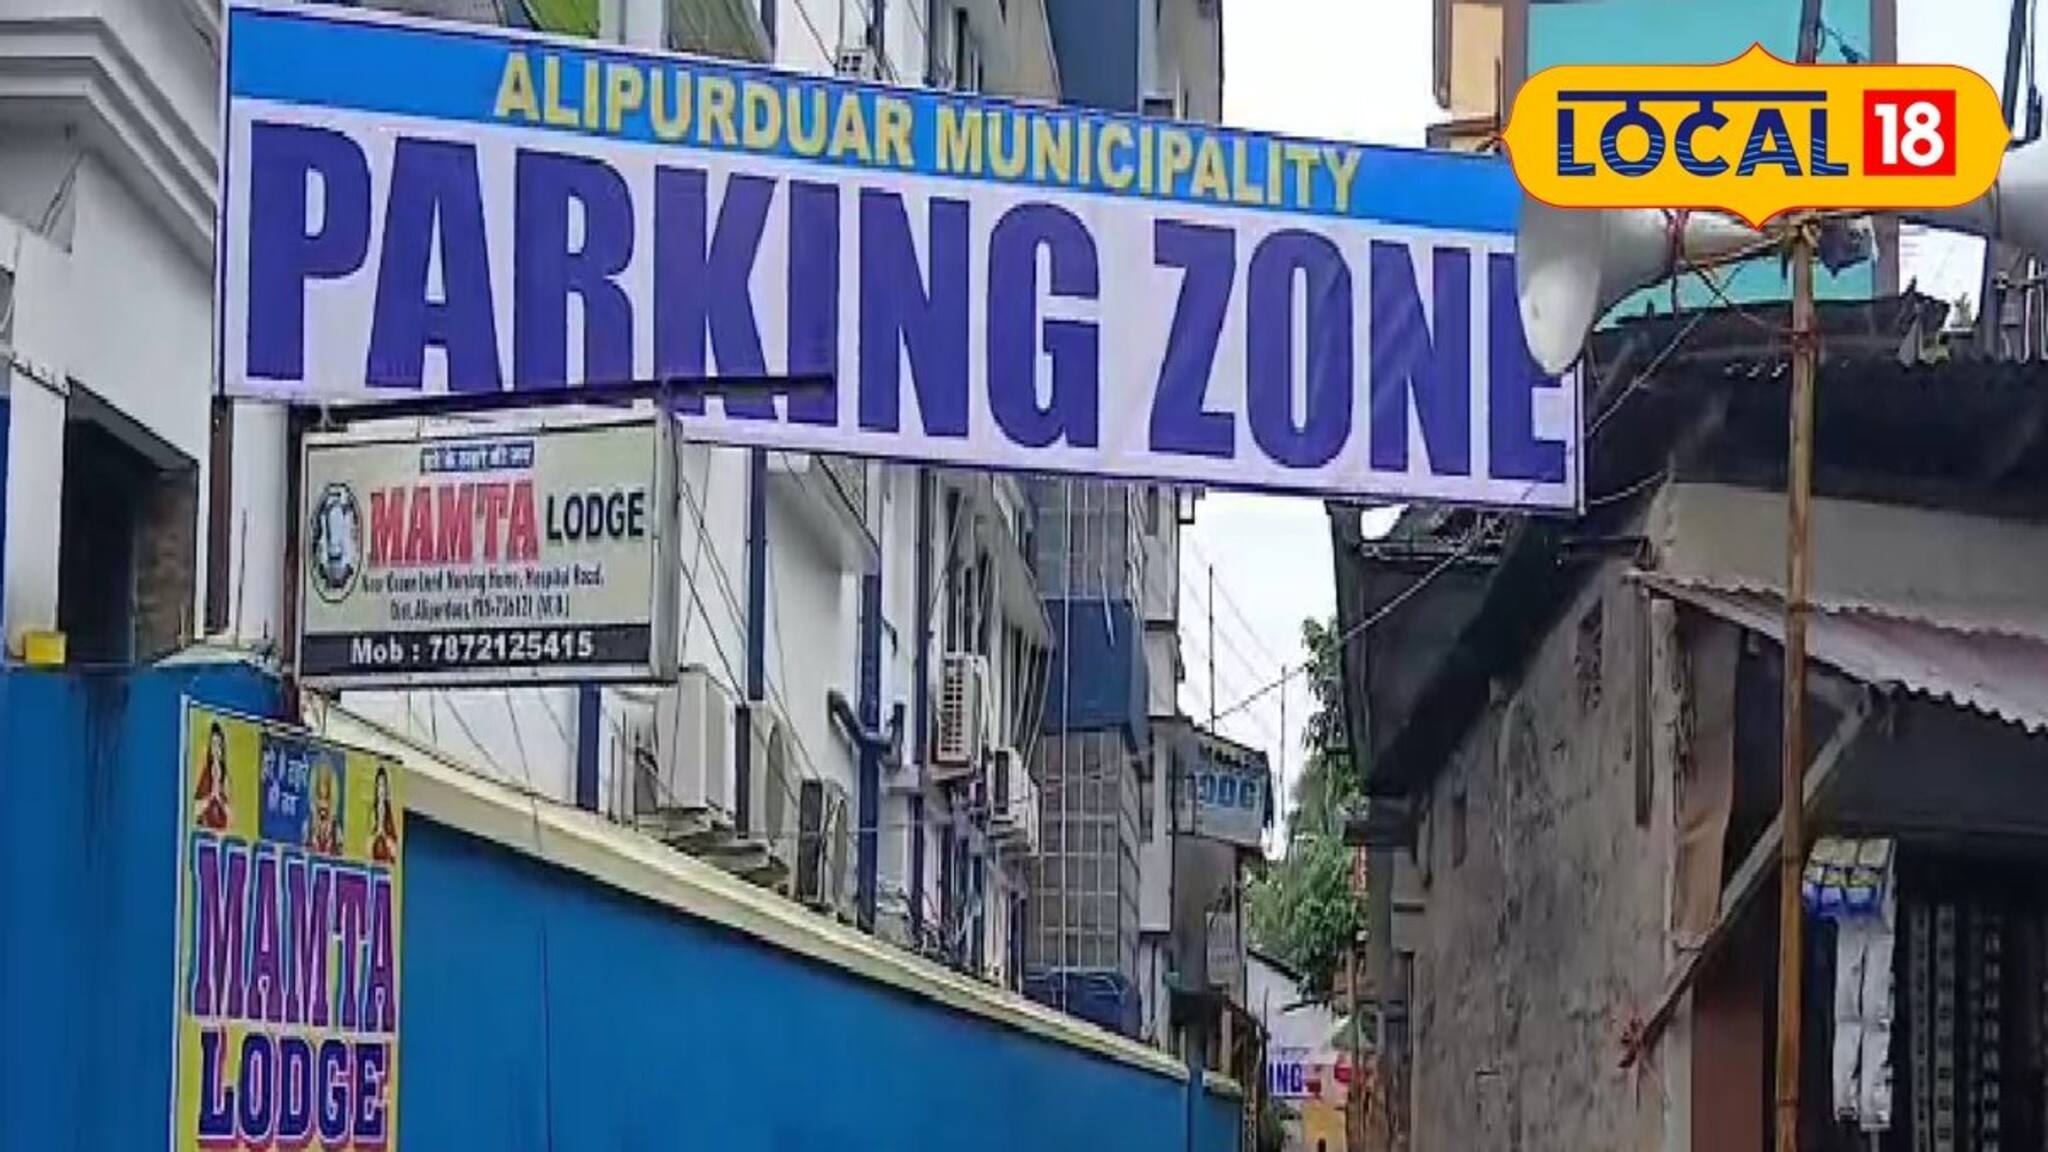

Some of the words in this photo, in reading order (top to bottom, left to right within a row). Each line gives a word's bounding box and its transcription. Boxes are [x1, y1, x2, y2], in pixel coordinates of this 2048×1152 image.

[495, 52, 915, 167] ALIPURDUAR
[936, 107, 1361, 212] MUNICIPALITY
[247, 120, 1100, 449] PARKING
[1149, 218, 1568, 484] ZONE
[369, 479, 540, 567] MAMTA
[546, 488, 645, 540] LODGE
[350, 636, 404, 664] Mob
[429, 631, 593, 662] 7872125415
[191, 837, 397, 1033] MAMTA
[197, 1030, 389, 1142] LODGE
